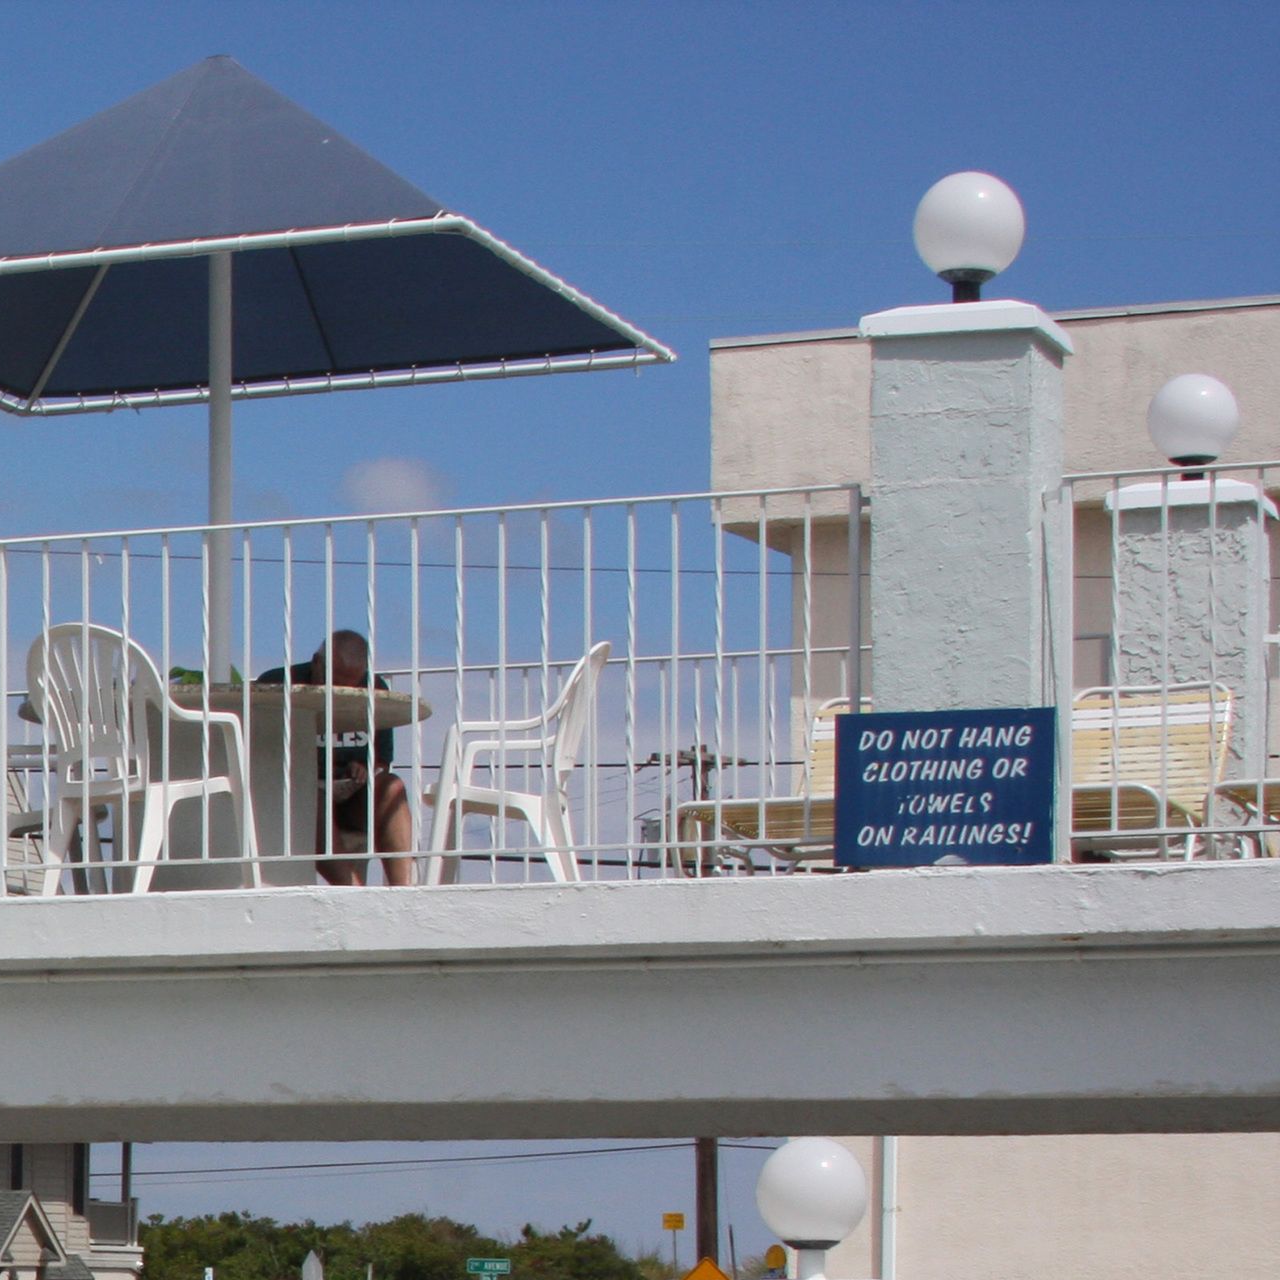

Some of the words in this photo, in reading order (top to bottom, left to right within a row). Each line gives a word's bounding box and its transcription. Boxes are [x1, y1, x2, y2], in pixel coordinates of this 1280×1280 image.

[858, 730, 894, 752] DO
[901, 728, 953, 750] NOT
[958, 725, 1032, 749] HANG
[862, 758, 983, 783] CLOTHING
[992, 757, 1028, 780] OR
[857, 825, 894, 847] ON
[901, 822, 1033, 846] RAILINGS!
